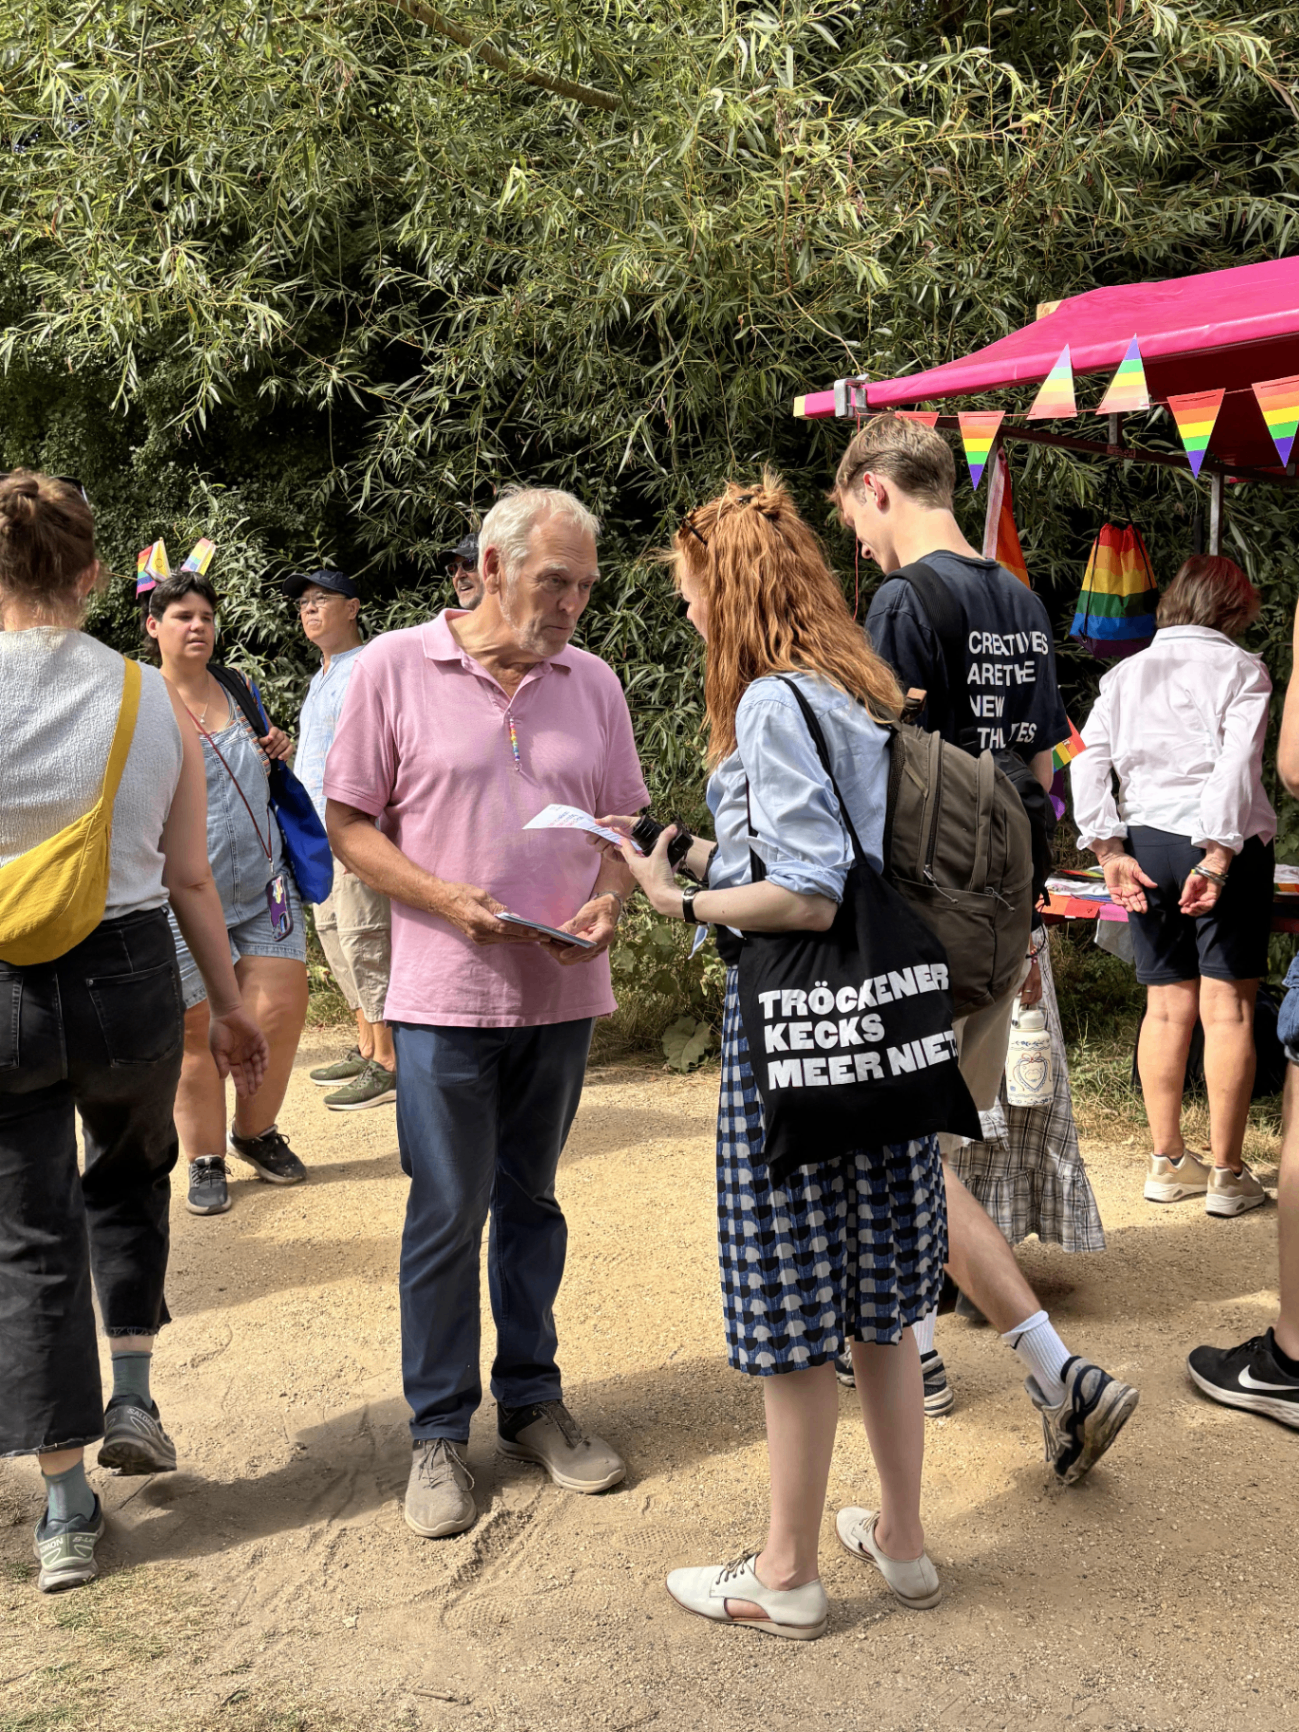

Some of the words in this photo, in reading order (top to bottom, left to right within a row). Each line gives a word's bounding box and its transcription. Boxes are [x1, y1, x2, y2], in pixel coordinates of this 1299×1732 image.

[968, 631, 1048, 656] CREATIVES
[967, 662, 1004, 685] ARE
[969, 695, 1005, 717] NEW
[758, 963, 949, 1019] TRÖCKENER
[764, 1013, 886, 1054] KECKS
[767, 1051, 885, 1091] MEER
